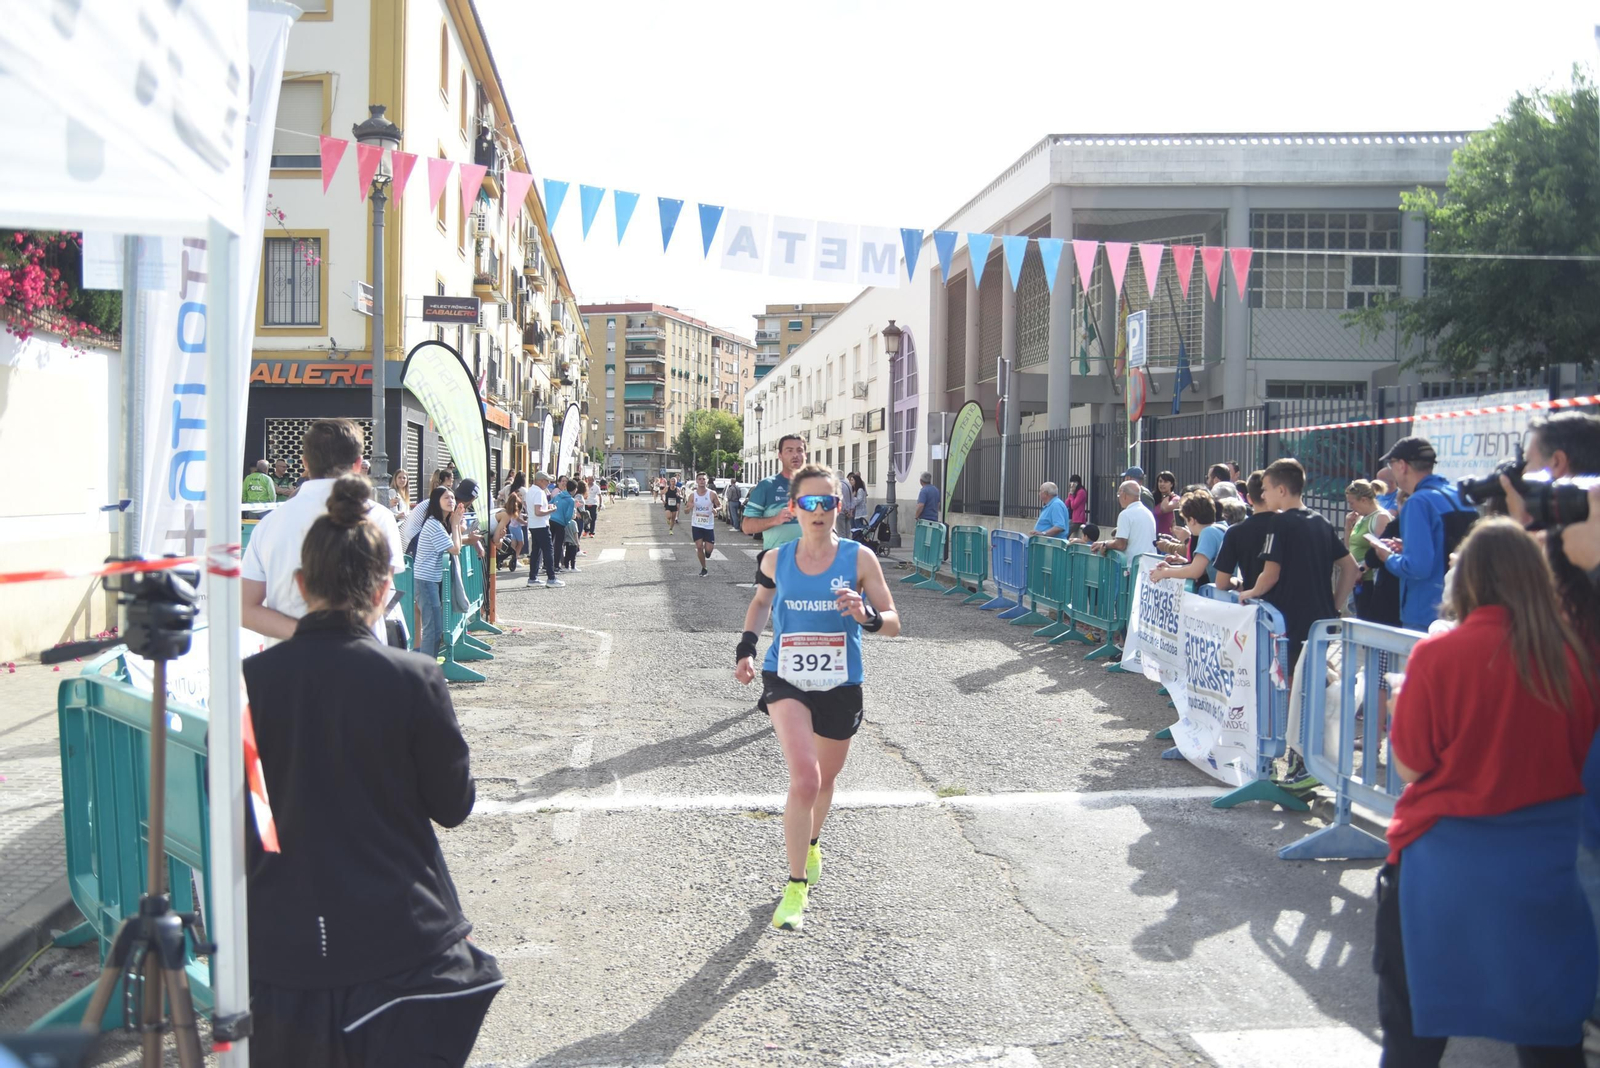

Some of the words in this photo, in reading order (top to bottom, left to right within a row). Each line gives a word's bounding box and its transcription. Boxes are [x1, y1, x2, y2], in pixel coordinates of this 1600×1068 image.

[425, 308, 477, 318] CABALLERO
[1129, 320, 1140, 361] P
[784, 599, 840, 612] TROTASIERR
[792, 653, 832, 672] 392
